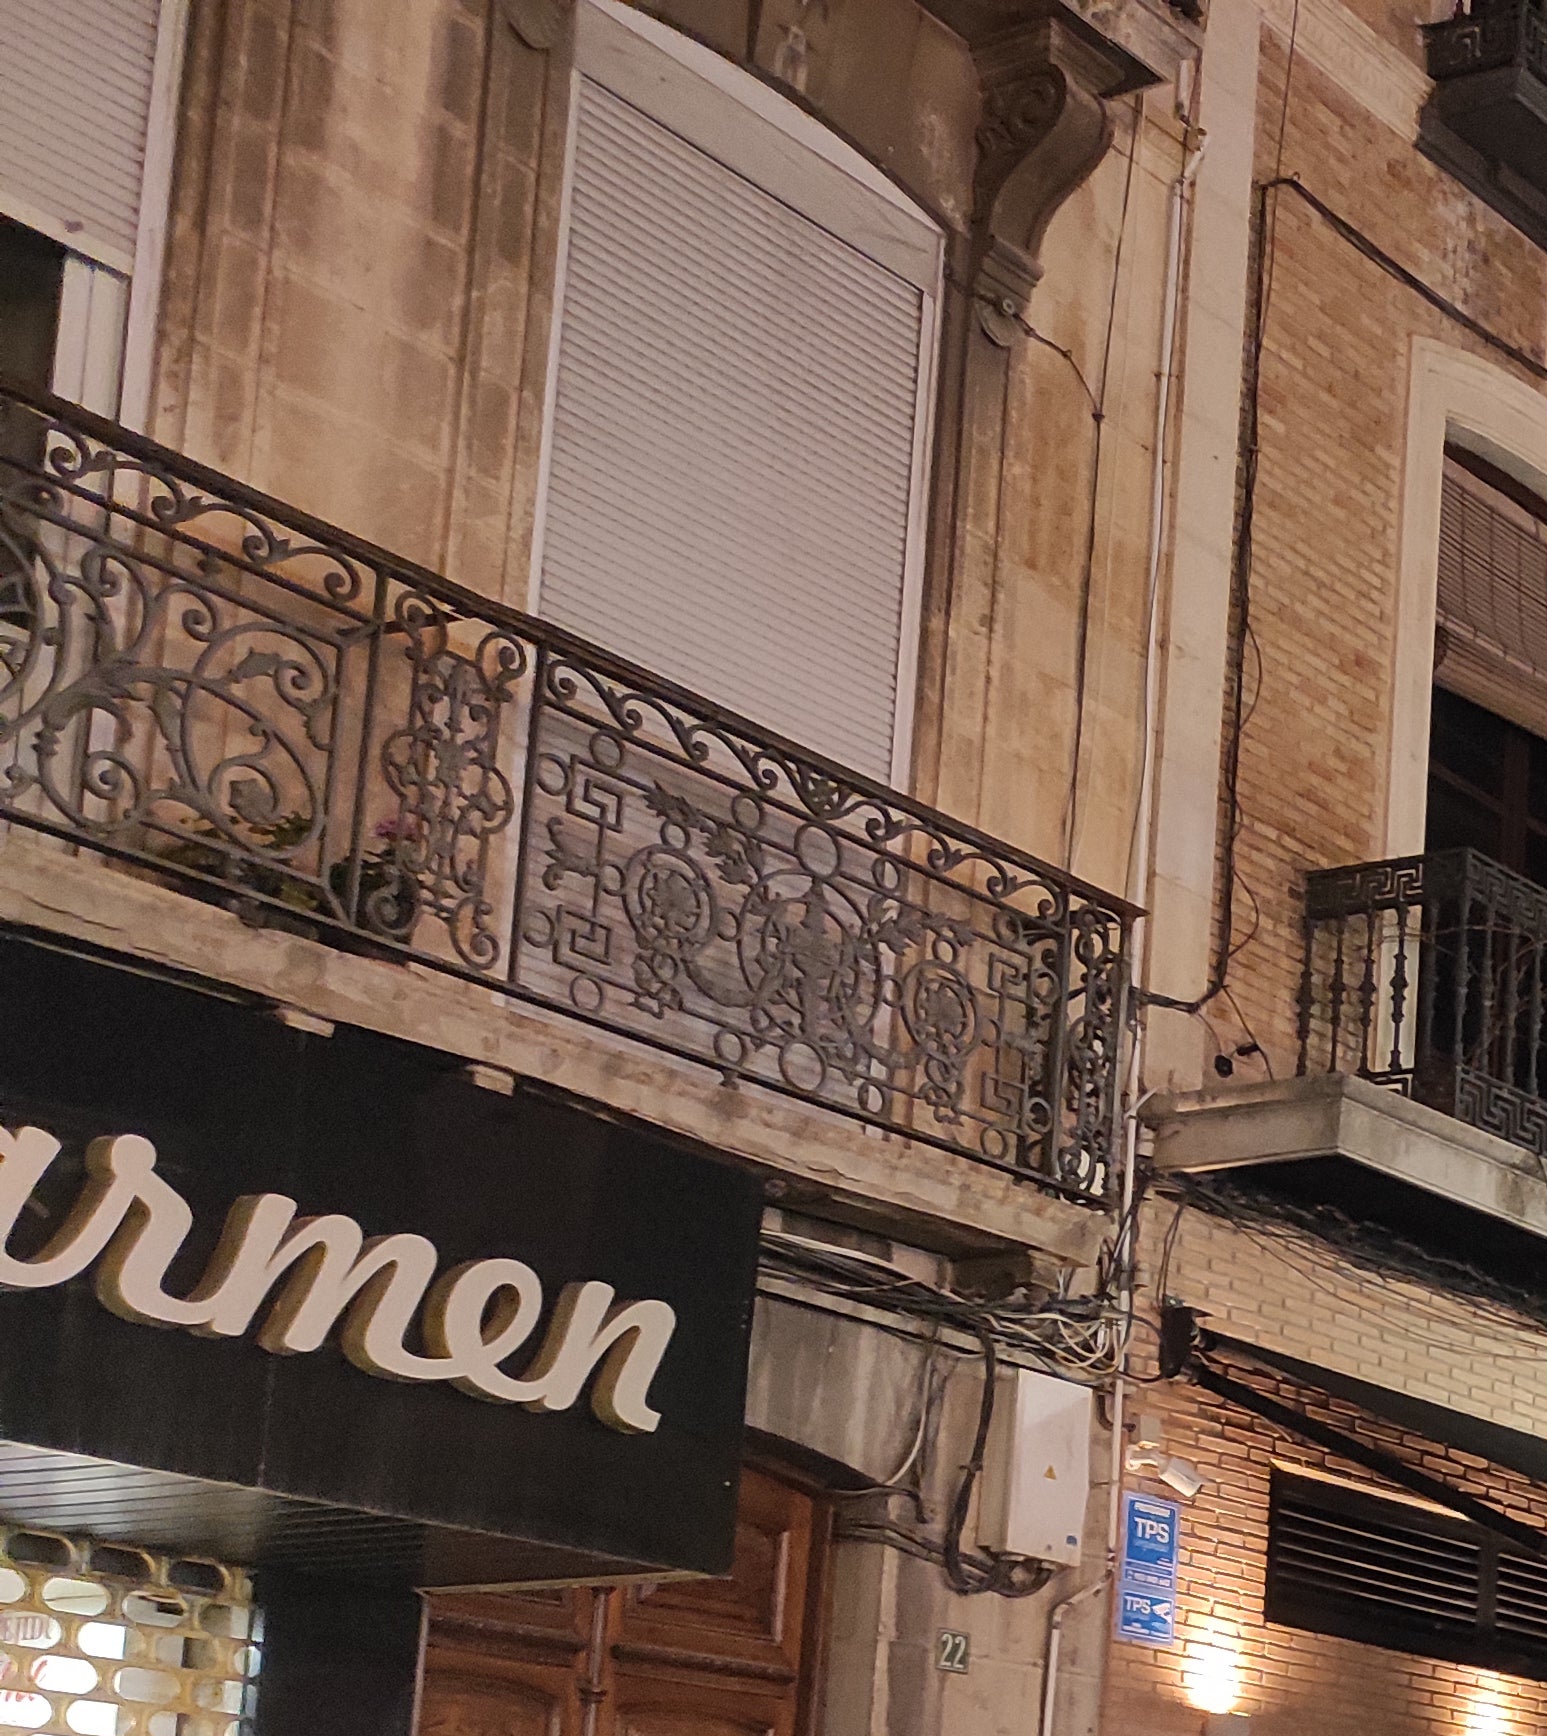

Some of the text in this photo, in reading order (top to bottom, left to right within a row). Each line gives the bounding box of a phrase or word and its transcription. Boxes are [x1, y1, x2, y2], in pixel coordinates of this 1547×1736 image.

[1134, 1516, 1170, 1544] TPS
[1124, 1596, 1151, 1615] TPS
[940, 1633, 966, 1668] 22
